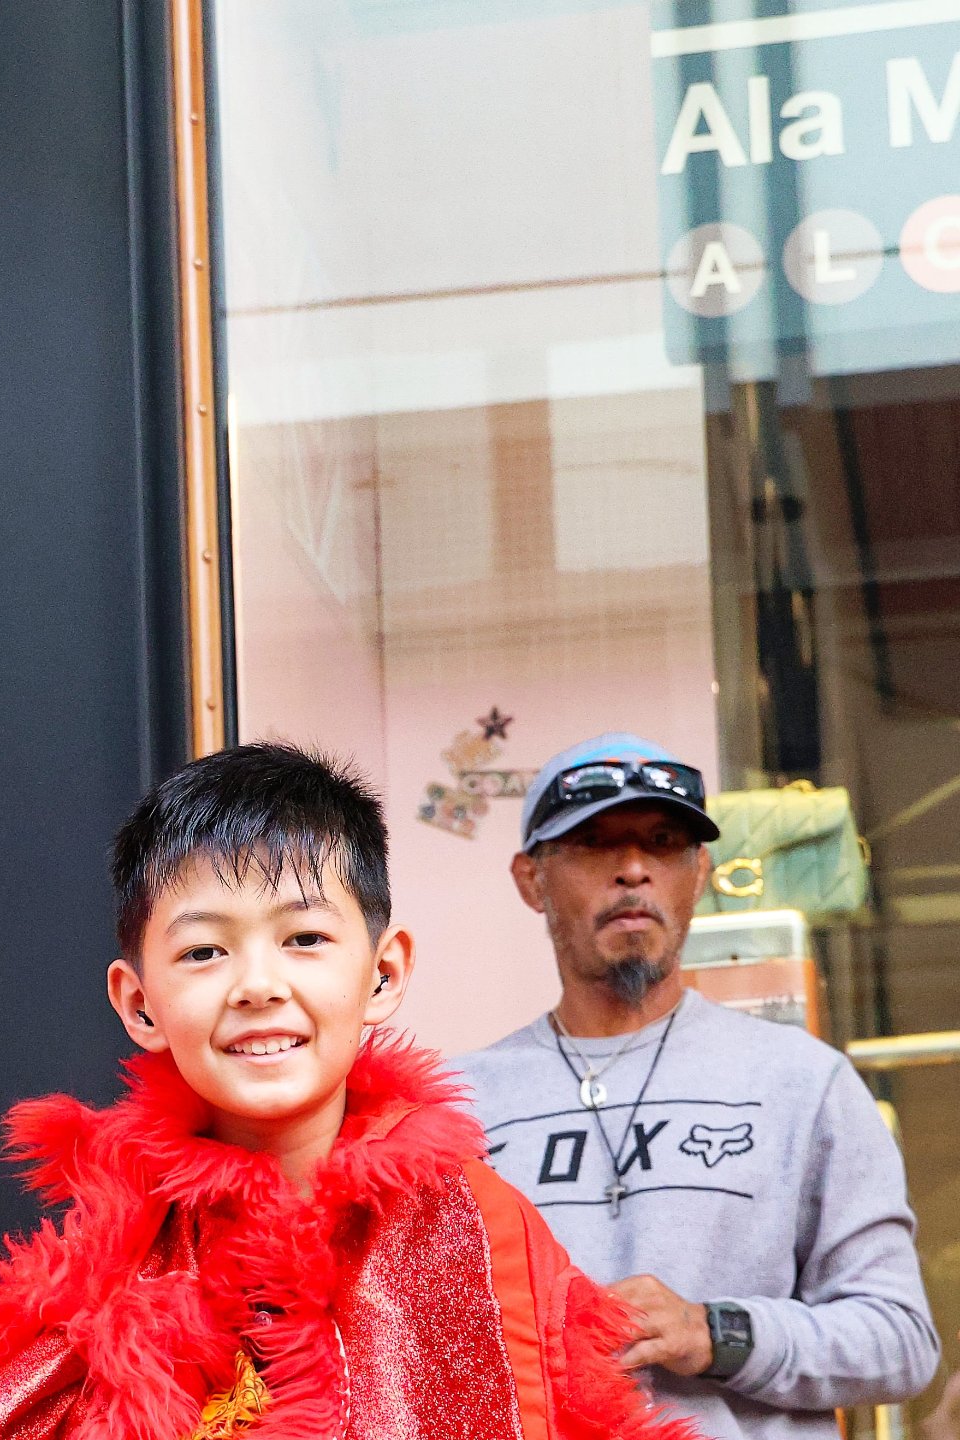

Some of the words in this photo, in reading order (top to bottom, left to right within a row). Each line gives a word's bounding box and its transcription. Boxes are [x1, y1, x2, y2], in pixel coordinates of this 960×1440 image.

[660, 76, 846, 175] Ala
[689, 242, 741, 298] A
[813, 230, 856, 284] L
[462, 773, 528, 797] COA
[487, 1120, 670, 1185] OX
